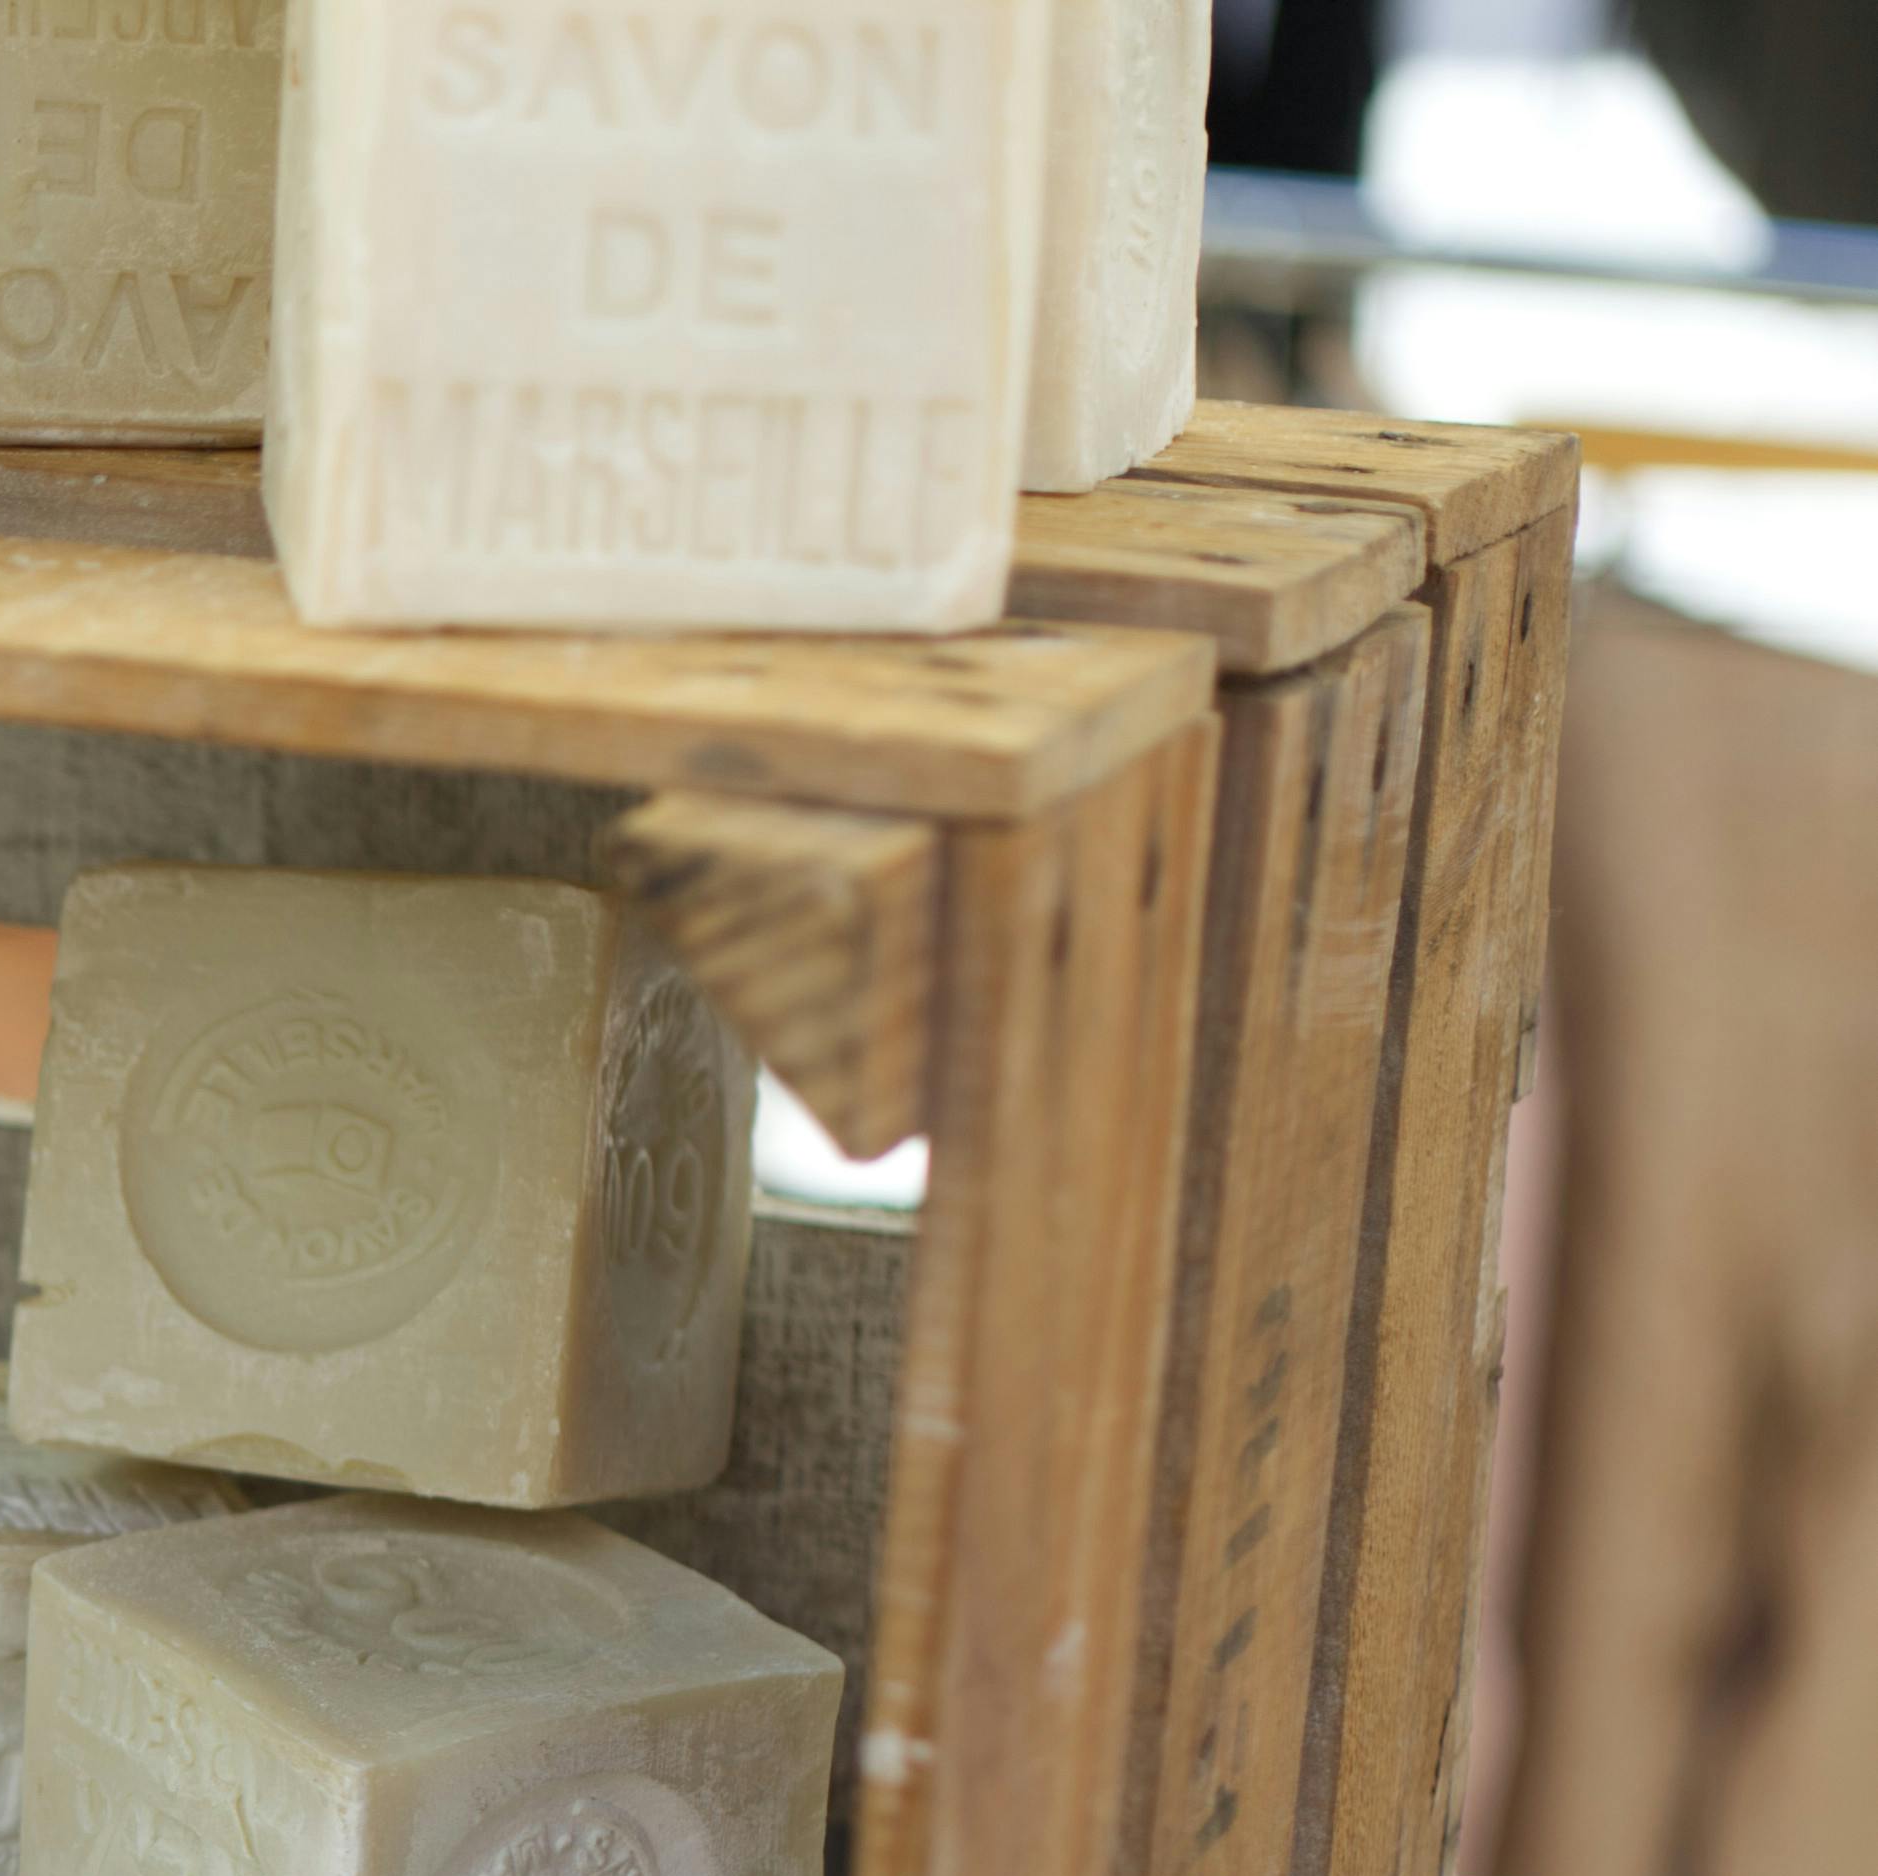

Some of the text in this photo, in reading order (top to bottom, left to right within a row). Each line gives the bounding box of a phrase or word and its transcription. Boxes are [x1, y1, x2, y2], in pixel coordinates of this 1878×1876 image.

[422, 16, 944, 138] SAVON
[32, 100, 206, 205] DE
[574, 206, 789, 330] DE
[372, 375, 978, 572] MARSEILLE
